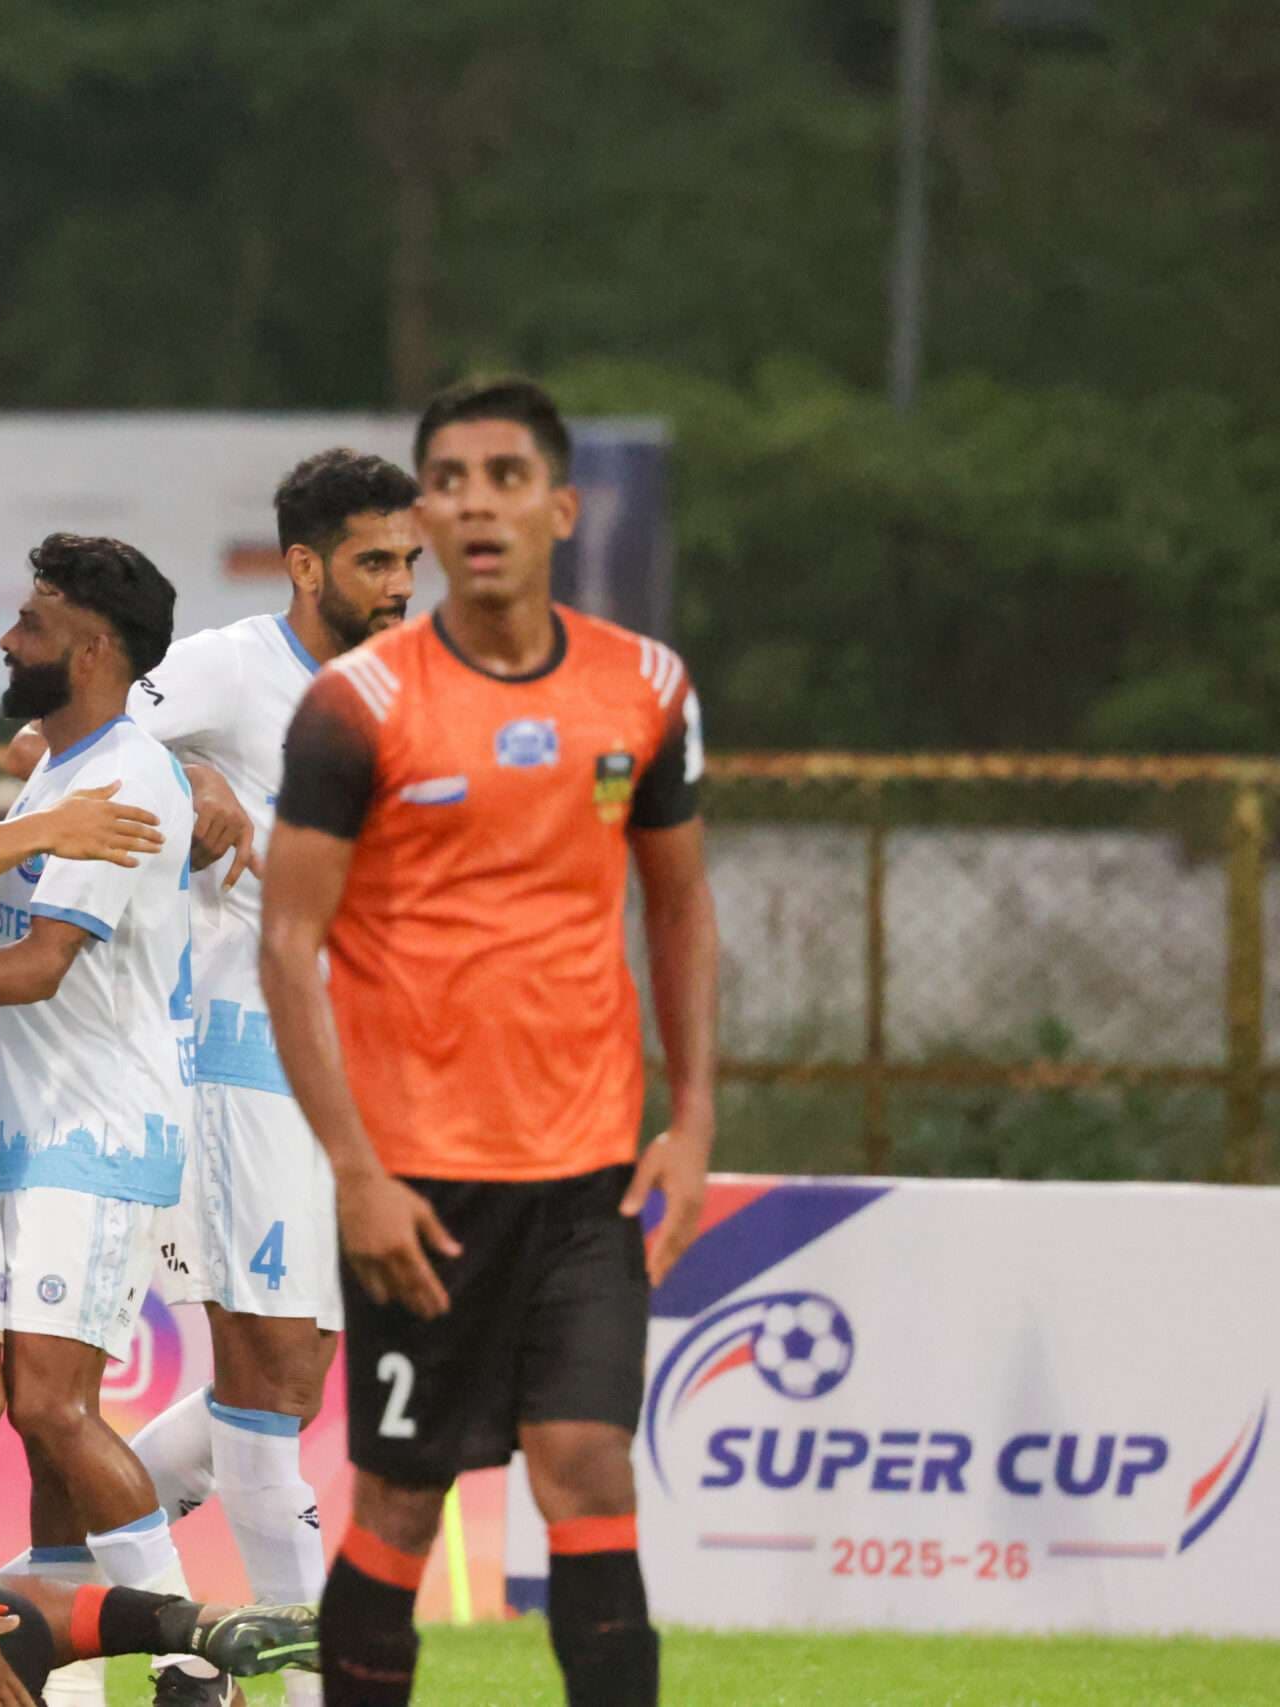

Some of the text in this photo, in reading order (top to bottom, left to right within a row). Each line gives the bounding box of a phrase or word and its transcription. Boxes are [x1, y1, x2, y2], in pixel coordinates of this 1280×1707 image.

[249, 1220, 287, 1290] 4
[376, 1350, 417, 1439] 2
[701, 1427, 1169, 1498] SUPER CUP
[831, 1537, 1031, 1580] 2025-26
